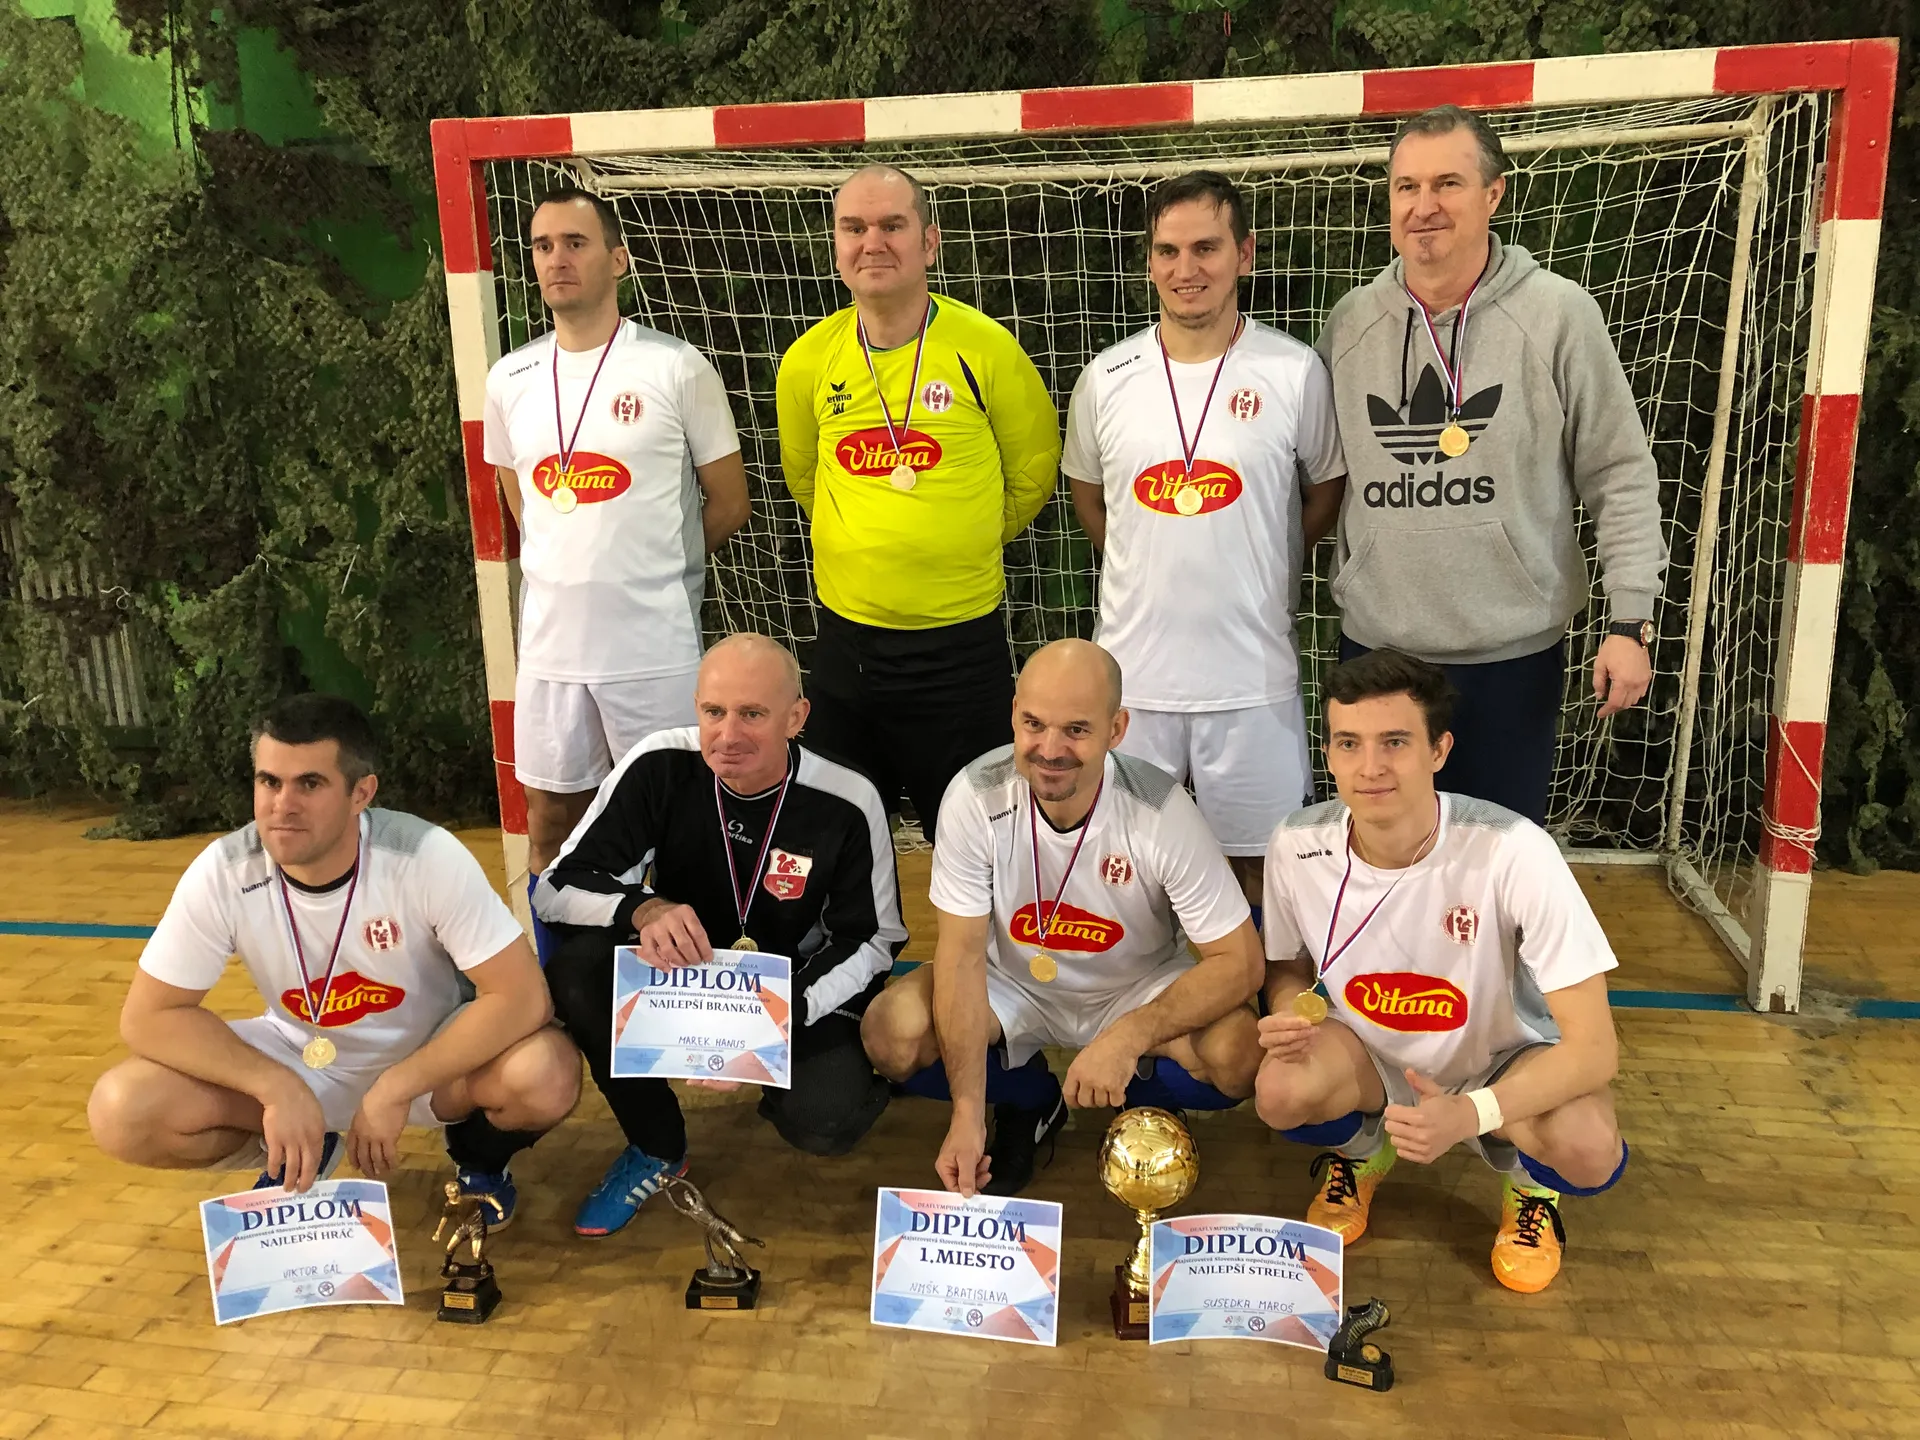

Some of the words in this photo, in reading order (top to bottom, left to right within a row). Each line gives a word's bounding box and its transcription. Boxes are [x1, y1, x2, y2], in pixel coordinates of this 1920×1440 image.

[1107, 358, 1132, 374] luanvi
[827, 394, 852, 403] erima
[841, 440, 935, 470] Vitana
[539, 462, 621, 490] Vitana
[1141, 471, 1233, 502] Vitna
[1363, 471, 1496, 508] adidas
[989, 808, 1012, 822] luanvi
[648, 966, 763, 993] DIPLOM
[649, 998, 703, 1010] NAJLEPŠÍ
[706, 1001, 762, 1015] BRANKÁR
[1354, 981, 1460, 1018] Vitana
[678, 1036, 710, 1046] MAREK
[715, 1038, 746, 1049] HANUS
[241, 1199, 363, 1231] DIPLOM
[911, 1211, 1027, 1243] DIPLOM
[260, 1230, 318, 1249] NAJLEPŠÍ
[321, 1227, 354, 1240] HRÁČ
[1184, 1234, 1308, 1262] DIPLOM
[919, 1247, 1015, 1271] 1.MIESTO
[283, 1265, 317, 1279] VIKTOR
[1188, 1263, 1245, 1276] NAJLEPŠÍ
[1248, 1266, 1304, 1281] STRELEC
[945, 1285, 1008, 1304] BRATISLAVA
